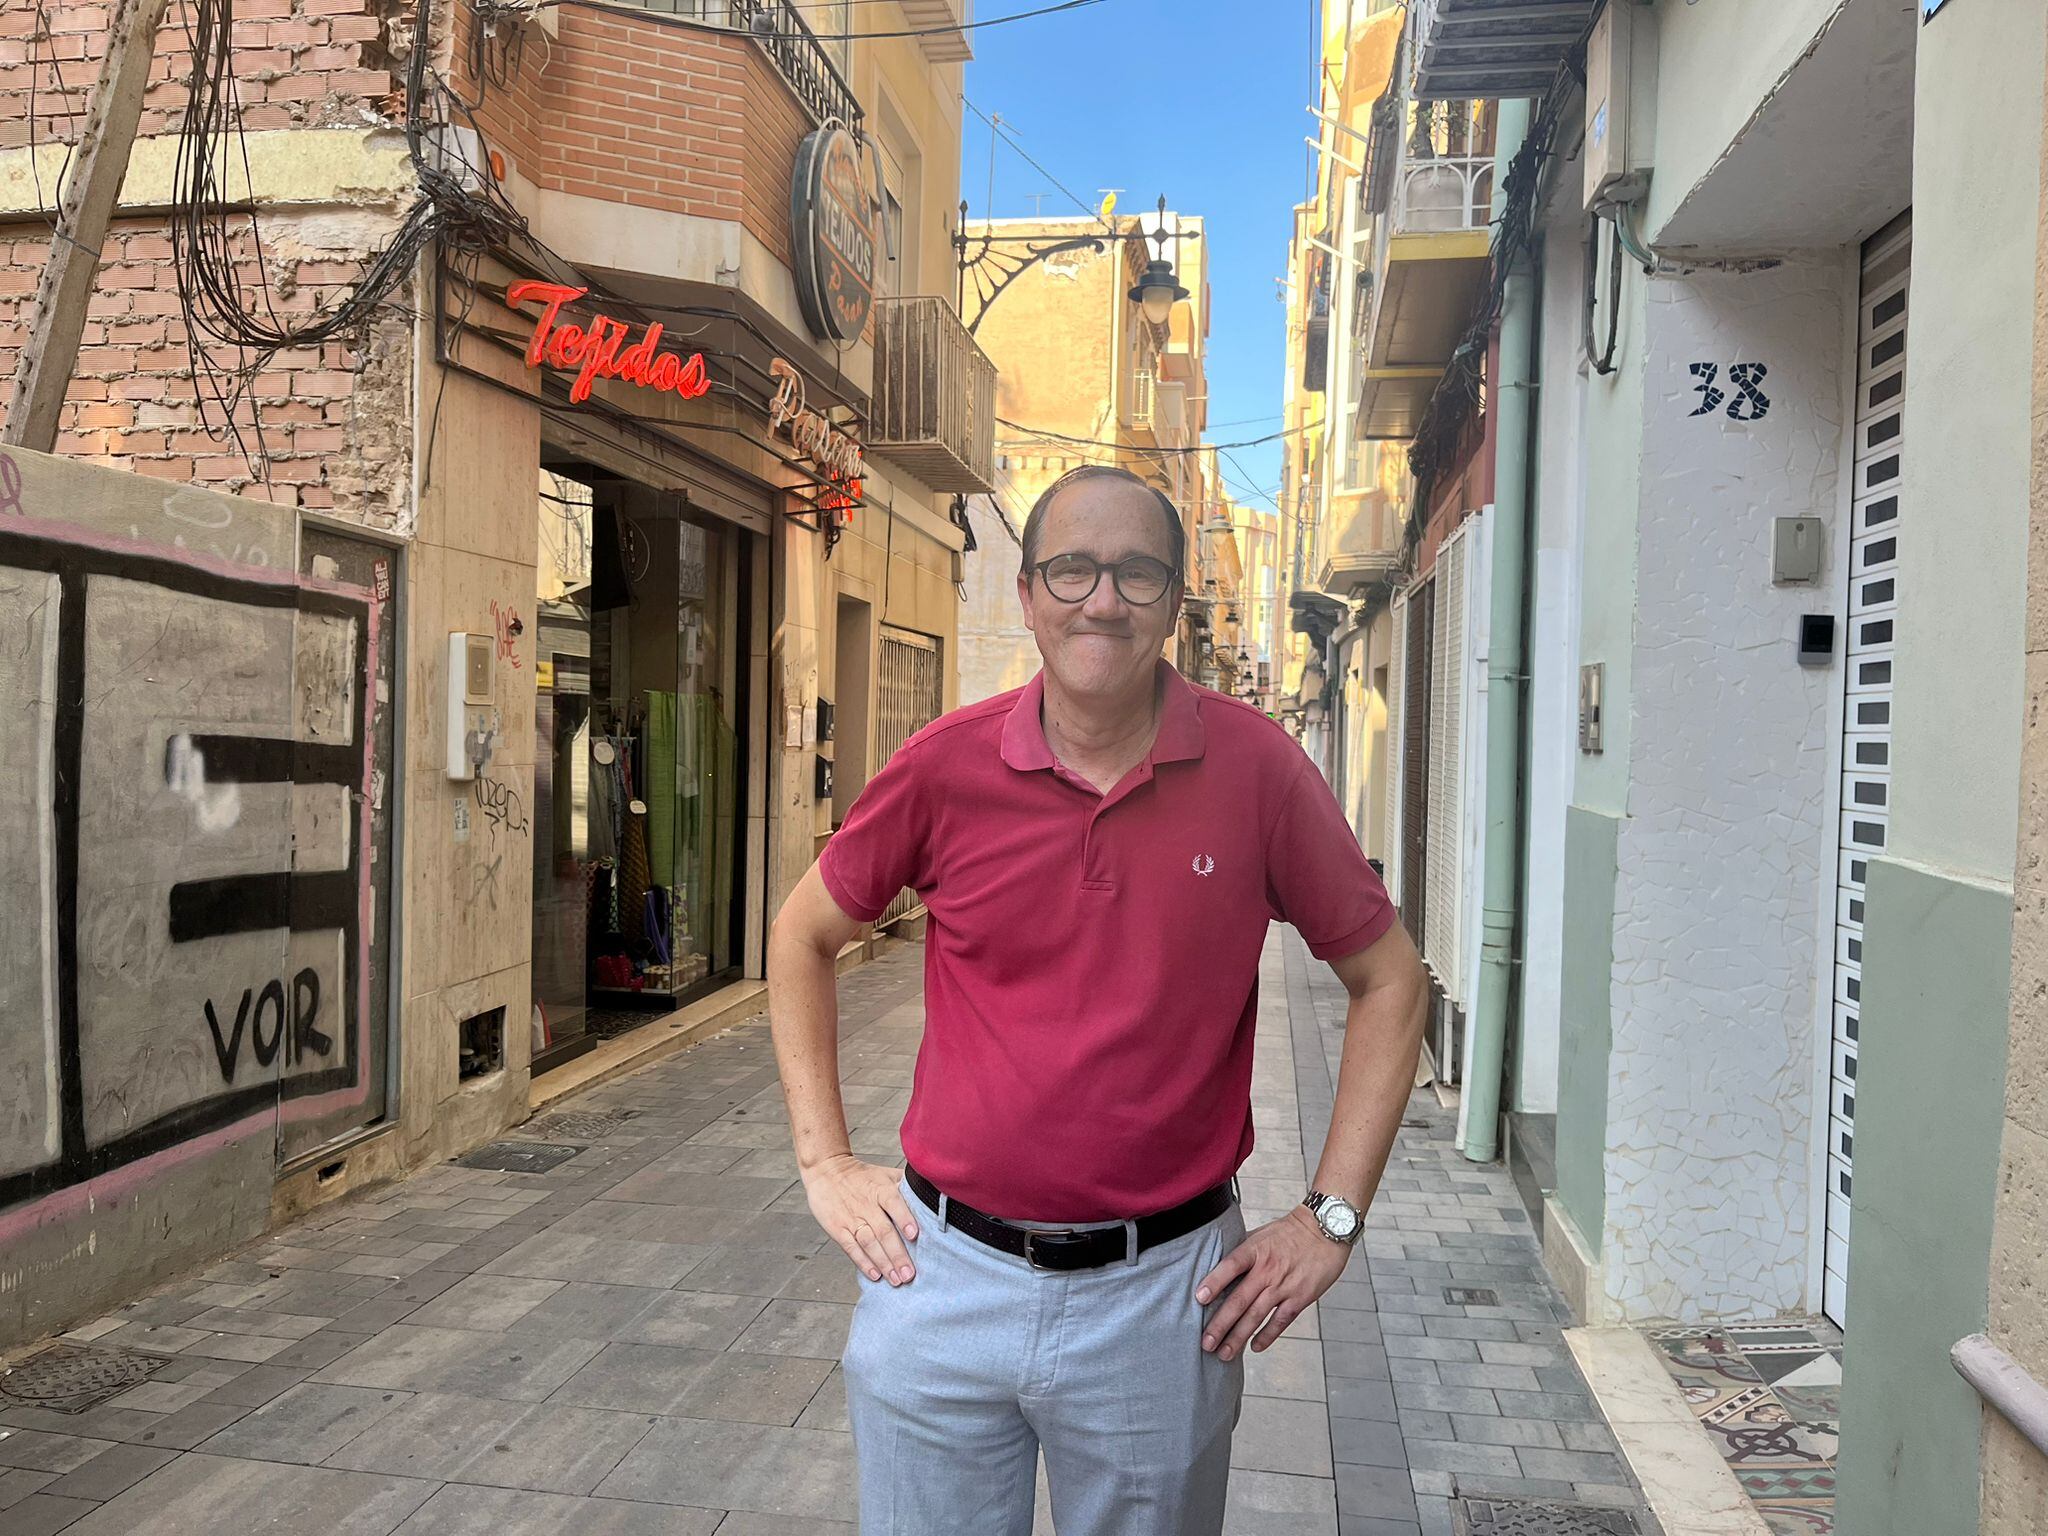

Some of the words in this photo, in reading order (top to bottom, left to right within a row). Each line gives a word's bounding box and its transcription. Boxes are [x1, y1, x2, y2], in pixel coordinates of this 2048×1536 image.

[823, 192, 872, 282] TEJIDOS
[506, 279, 712, 405] Tejidos
[1687, 362, 1771, 421] 38
